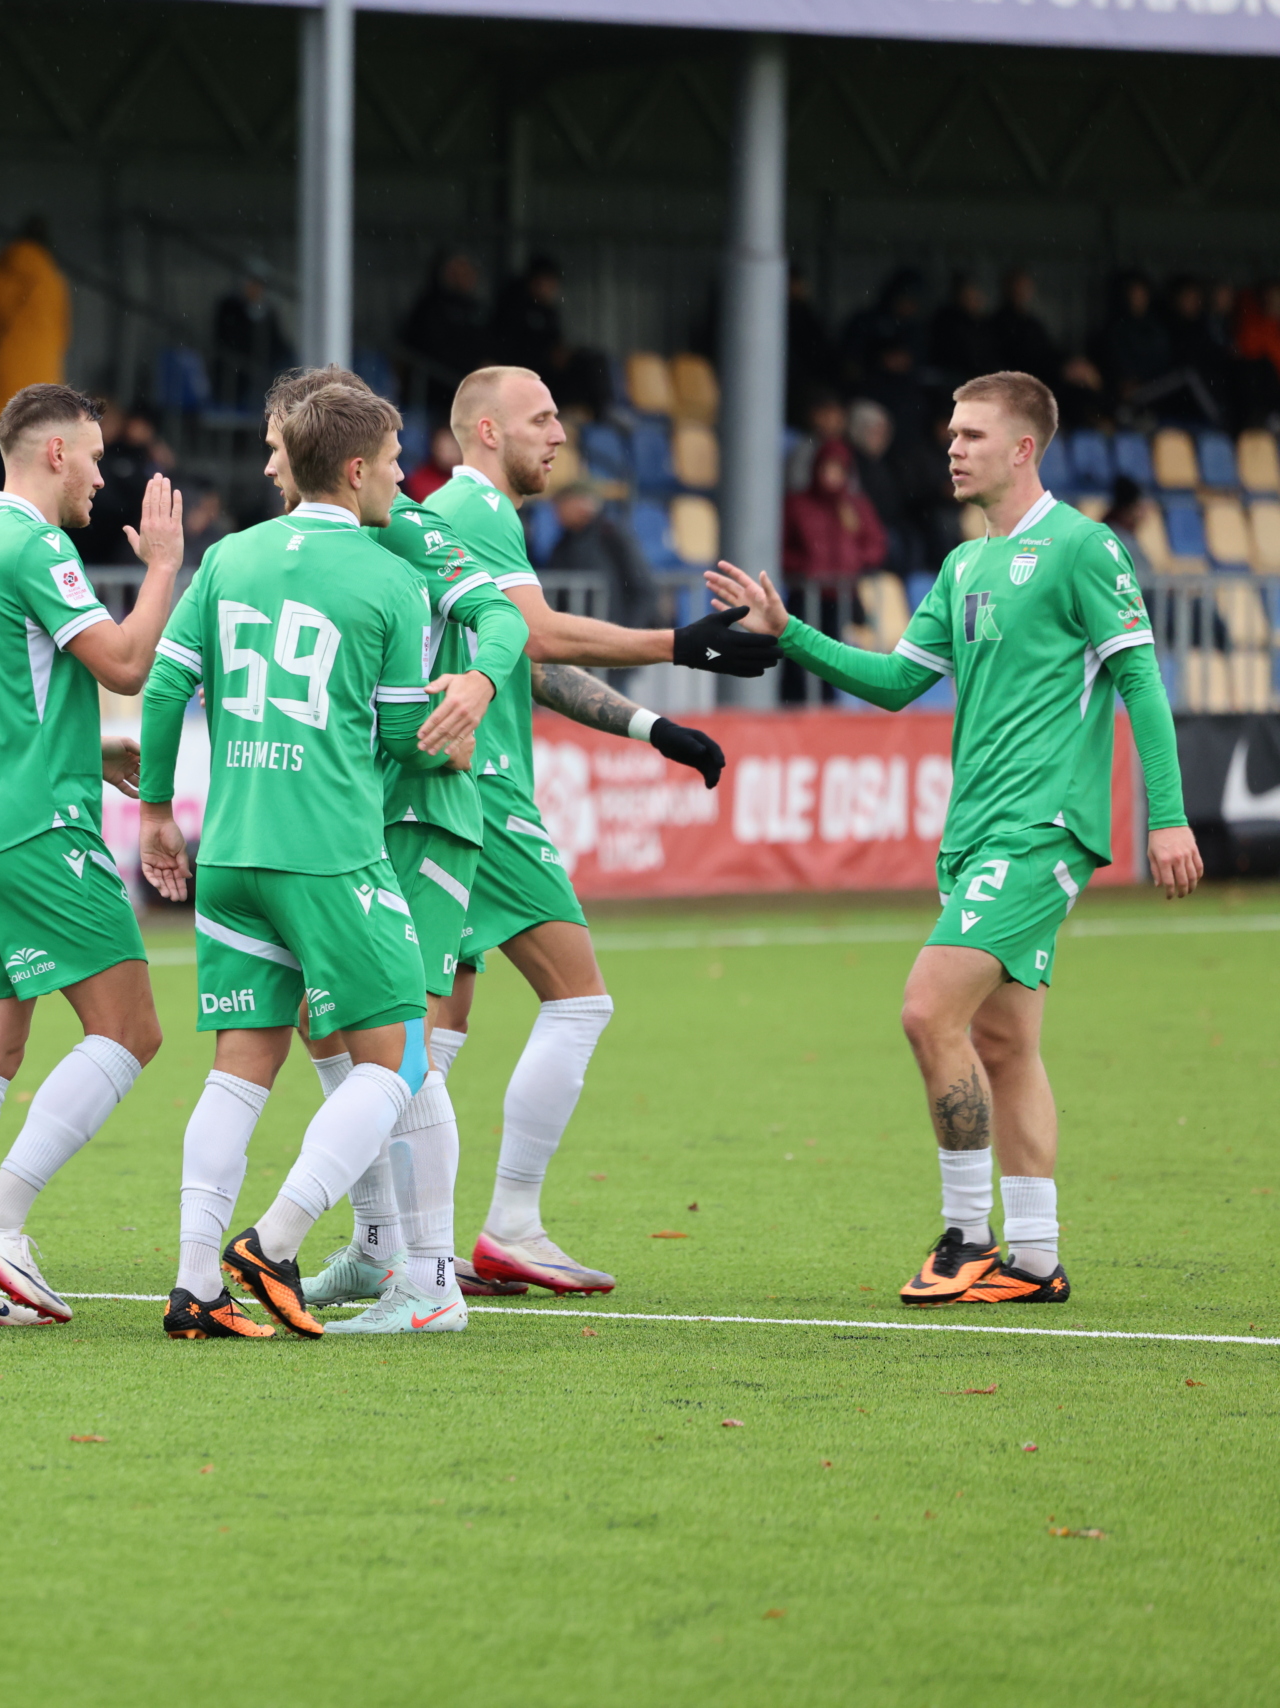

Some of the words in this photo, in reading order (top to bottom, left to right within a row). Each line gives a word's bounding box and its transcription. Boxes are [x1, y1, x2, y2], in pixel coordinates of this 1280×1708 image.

[218, 599, 342, 731] 59
[732, 754, 818, 844] OLE
[964, 859, 1010, 902] 2
[31, 960, 56, 977] Läte
[200, 988, 256, 1015] Delfi
